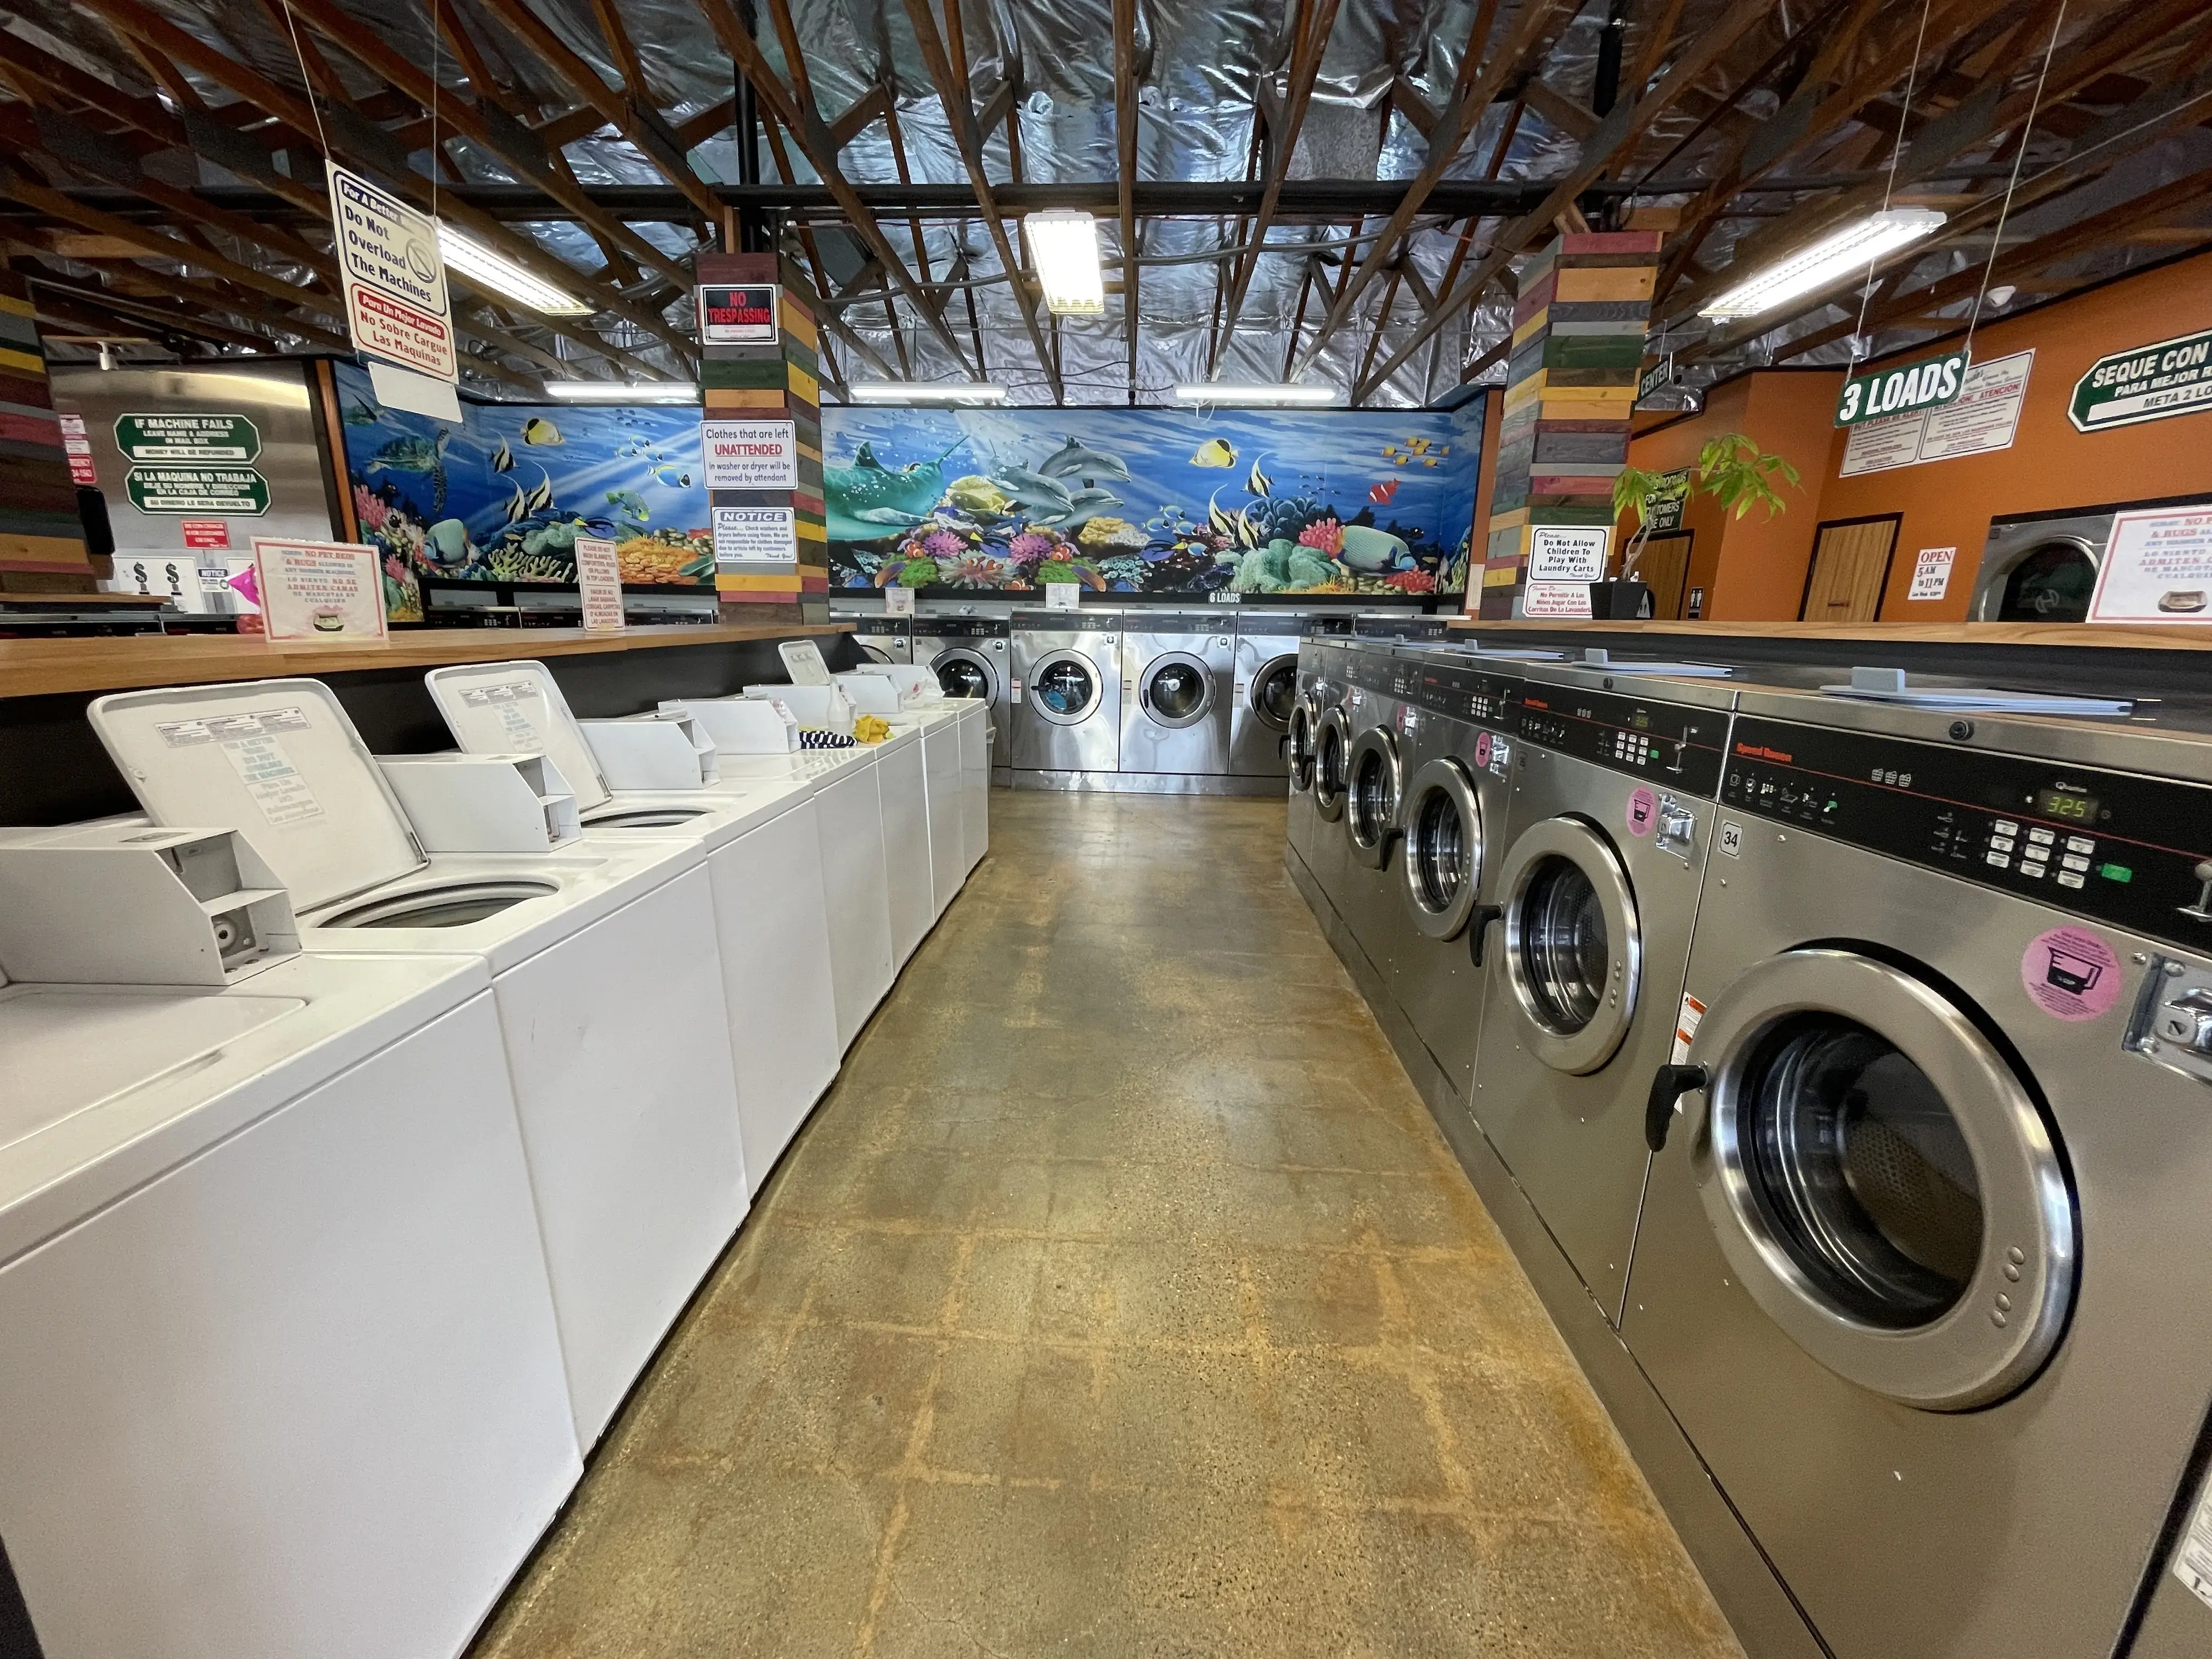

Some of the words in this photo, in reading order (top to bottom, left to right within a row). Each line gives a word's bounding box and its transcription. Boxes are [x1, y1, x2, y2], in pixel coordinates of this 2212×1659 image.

[343, 183, 359, 200] For
[362, 194, 369, 206] A
[370, 198, 399, 221] Better
[345, 205, 363, 225] Do
[366, 216, 390, 240] Not
[349, 230, 406, 269] Overload
[351, 252, 375, 276] The
[379, 265, 431, 302] Machines
[729, 291, 747, 307] NO
[363, 295, 382, 311] Para
[383, 303, 394, 317] Un
[395, 310, 415, 326] Mejor
[708, 307, 770, 323] TRESPASSING
[360, 311, 376, 325] No
[379, 319, 410, 340] Sobre
[414, 333, 448, 355] Cargue
[373, 330, 391, 347] Las
[394, 338, 441, 366] Maquinas
[2092, 354, 2159, 388] SEQUE
[2162, 342, 2210, 371] CON
[1641, 360, 1668, 397] CENTER
[2114, 380, 2148, 397] PARA
[2151, 369, 2199, 389] MEJOR
[1839, 383, 1861, 421] 3
[1865, 358, 1961, 415] LOADS
[2143, 392, 2179, 409] META
[2183, 390, 2192, 400] 2
[134, 419, 145, 429] IF
[148, 419, 199, 429] MACHINE
[202, 419, 234, 430] FAILS
[706, 428, 737, 439] Clothes
[740, 428, 757, 438] that
[775, 428, 789, 438] left
[714, 444, 782, 455] UNATTENDED
[716, 461, 741, 470] washer
[751, 461, 768, 472] dryer
[769, 461, 781, 470] will
[782, 461, 791, 470] be
[133, 471, 143, 482] SI
[144, 471, 156, 482] LA
[157, 472, 198, 482] MAQUINA
[200, 472, 214, 482] NO
[215, 473, 257, 483] TRABAJA
[715, 473, 742, 481] removed
[744, 473, 752, 483] by
[754, 473, 787, 481] attendant
[723, 512, 784, 521] NOTICE
[1659, 515, 1674, 528] ONLY
[1921, 551, 1953, 563] OPEN
[1539, 565, 1571, 573] Laundry
[1217, 592, 1240, 603] LOADS
[1724, 831, 1737, 847] 34
